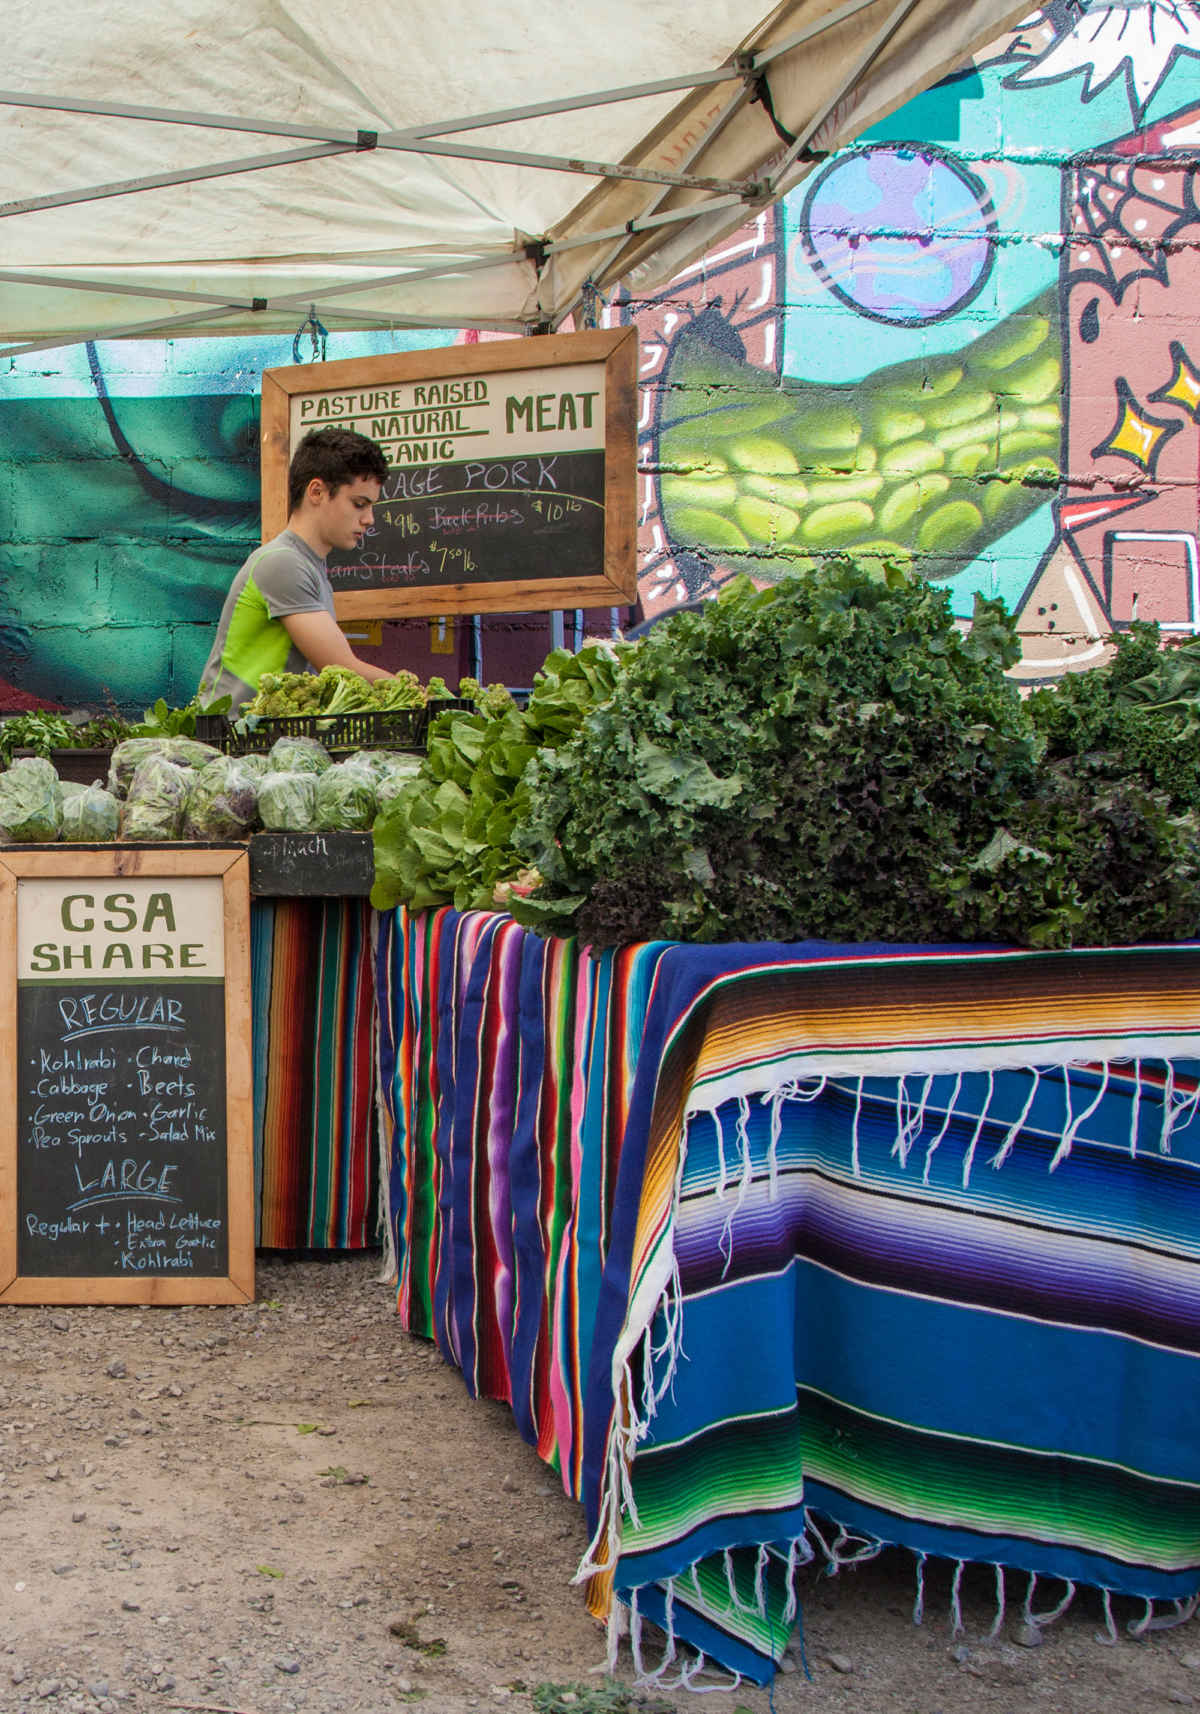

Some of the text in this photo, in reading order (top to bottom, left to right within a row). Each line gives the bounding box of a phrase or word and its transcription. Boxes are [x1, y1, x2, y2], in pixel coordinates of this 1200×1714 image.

[300, 380, 489, 417] PASTURE RAISED
[505, 391, 600, 434] MEAT
[371, 410, 470, 438] NATURAL
[383, 439, 455, 464] GANIC
[464, 456, 559, 489] PORK
[60, 892, 178, 933] CSA
[30, 943, 208, 972] SHARE
[58, 993, 186, 1030] REGULAR
[40, 1046, 192, 1074] Kohlrabi Chard
[36, 1069, 196, 1106] Cabbage Beets
[33, 1101, 208, 1126] Green Onion Garlic
[67, 1126, 129, 1159] Sprouts
[149, 1121, 189, 1143] Salad
[195, 1124, 216, 1143] Mix
[74, 1158, 178, 1193] LARGE
[127, 1210, 165, 1233] Head
[169, 1211, 222, 1230] Lettuce
[127, 1233, 217, 1250] Extra Garlic
[121, 1251, 193, 1271] Kohlrabi
